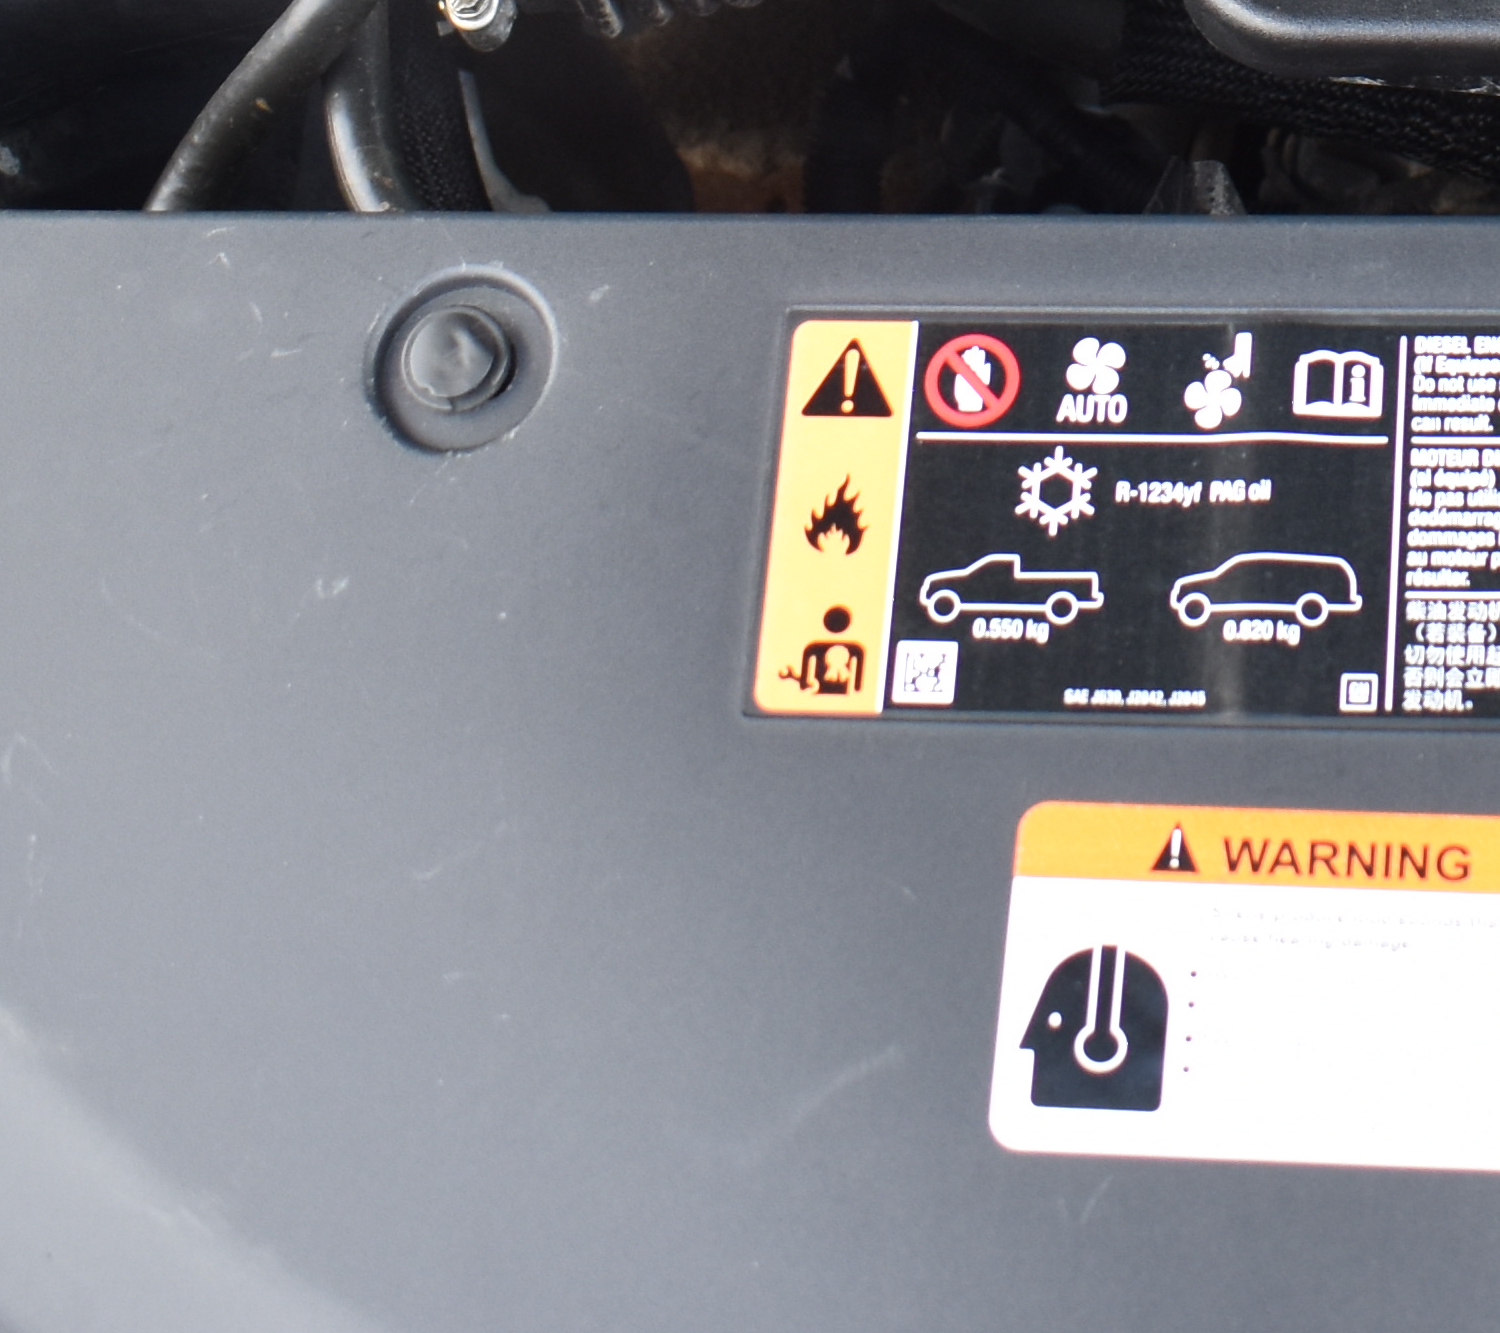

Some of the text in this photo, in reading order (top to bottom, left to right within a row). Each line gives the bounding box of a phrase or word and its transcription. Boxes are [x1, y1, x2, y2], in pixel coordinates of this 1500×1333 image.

[1414, 335, 1471, 354] DIESEL
[1413, 375, 1436, 392] Do
[1438, 376, 1465, 393] not
[1467, 377, 1497, 393] use
[1055, 393, 1128, 423] AUTO
[1412, 394, 1495, 412] Immediate
[1411, 414, 1494, 432] can result.
[1410, 448, 1479, 467] MOTEUR
[1115, 479, 1272, 508] R-1234yf PAG oil
[1434, 492, 1464, 509] pas
[1407, 528, 1496, 550] dommages
[1406, 551, 1428, 567] au
[1430, 550, 1488, 567] moteur
[1026, 617, 1050, 645] kg
[1276, 619, 1301, 647] kg
[1223, 836, 1474, 882] WARNING
